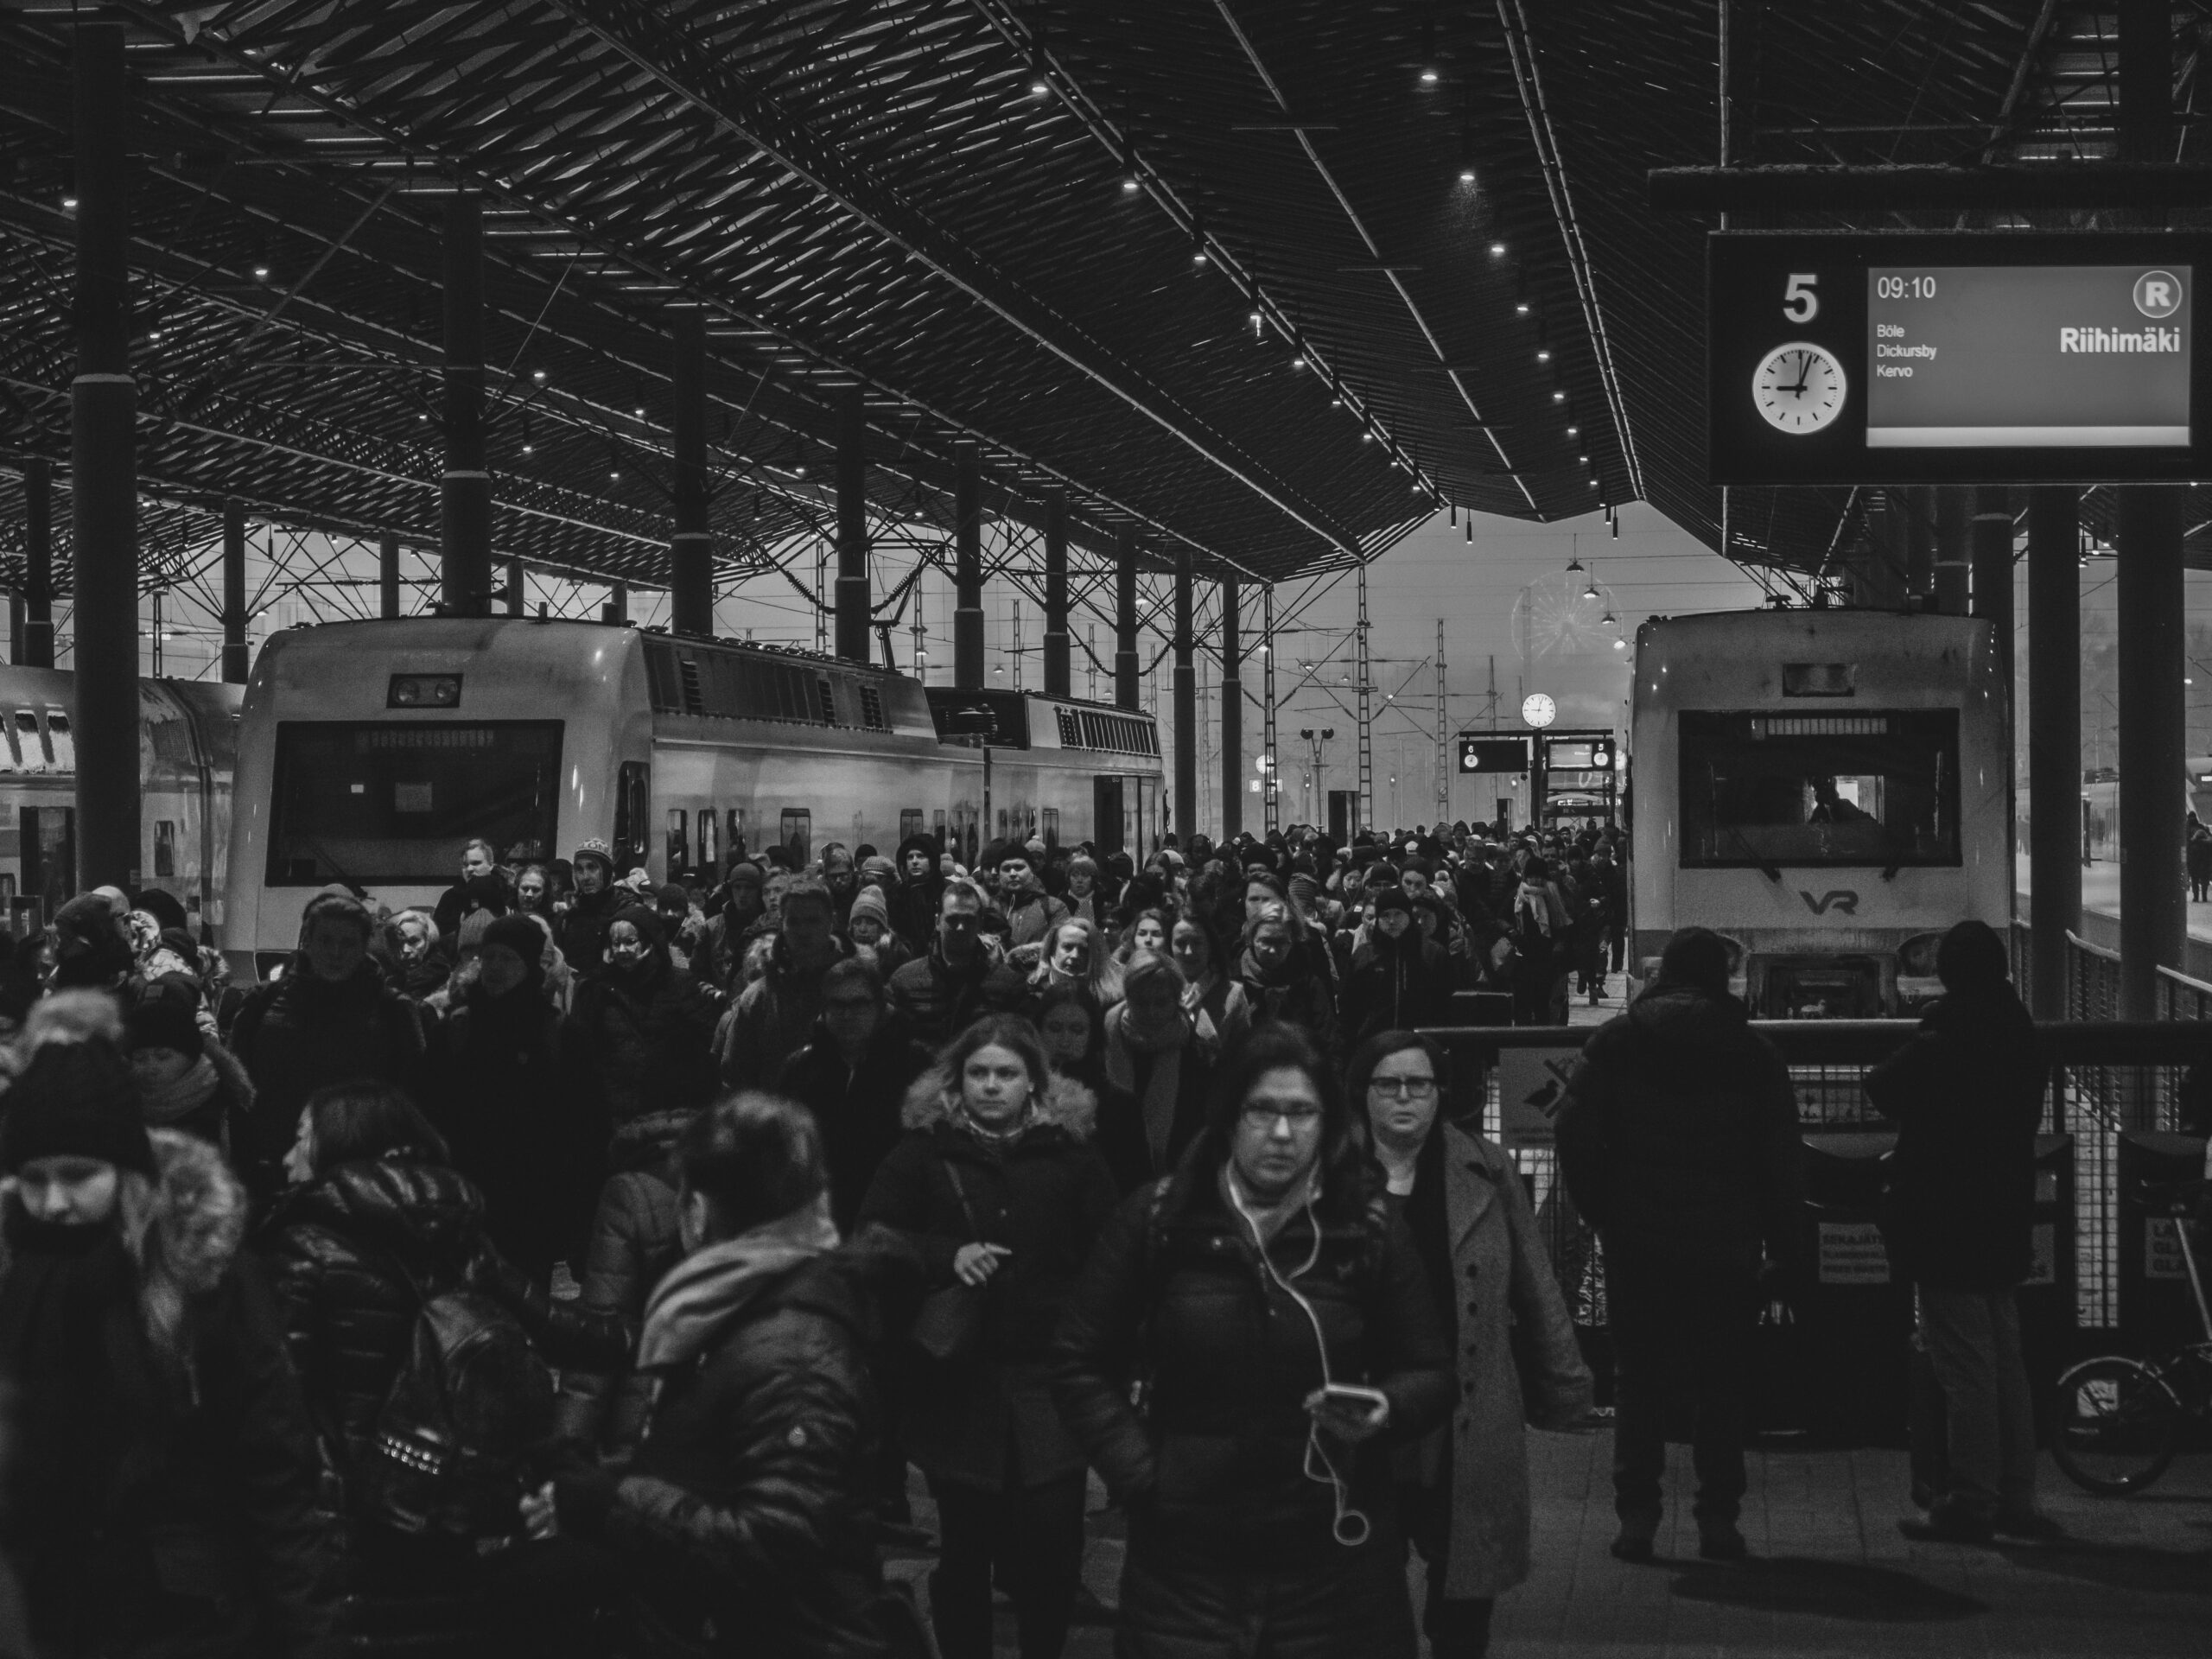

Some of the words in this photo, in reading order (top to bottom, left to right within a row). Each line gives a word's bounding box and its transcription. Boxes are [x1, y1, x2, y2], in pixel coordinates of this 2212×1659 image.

[1878, 276, 1936, 298] 09:10
[2145, 282, 2171, 307] R
[1783, 273, 1819, 323] 5
[1877, 324, 1905, 338] Böle
[2060, 327, 2180, 353] Riihimäki
[1877, 344, 1936, 360] Dickursby
[1877, 365, 1913, 378] Kervo
[1468, 745, 1474, 753] 6
[1252, 780, 1259, 791] 8
[1799, 890, 1859, 916] VR
